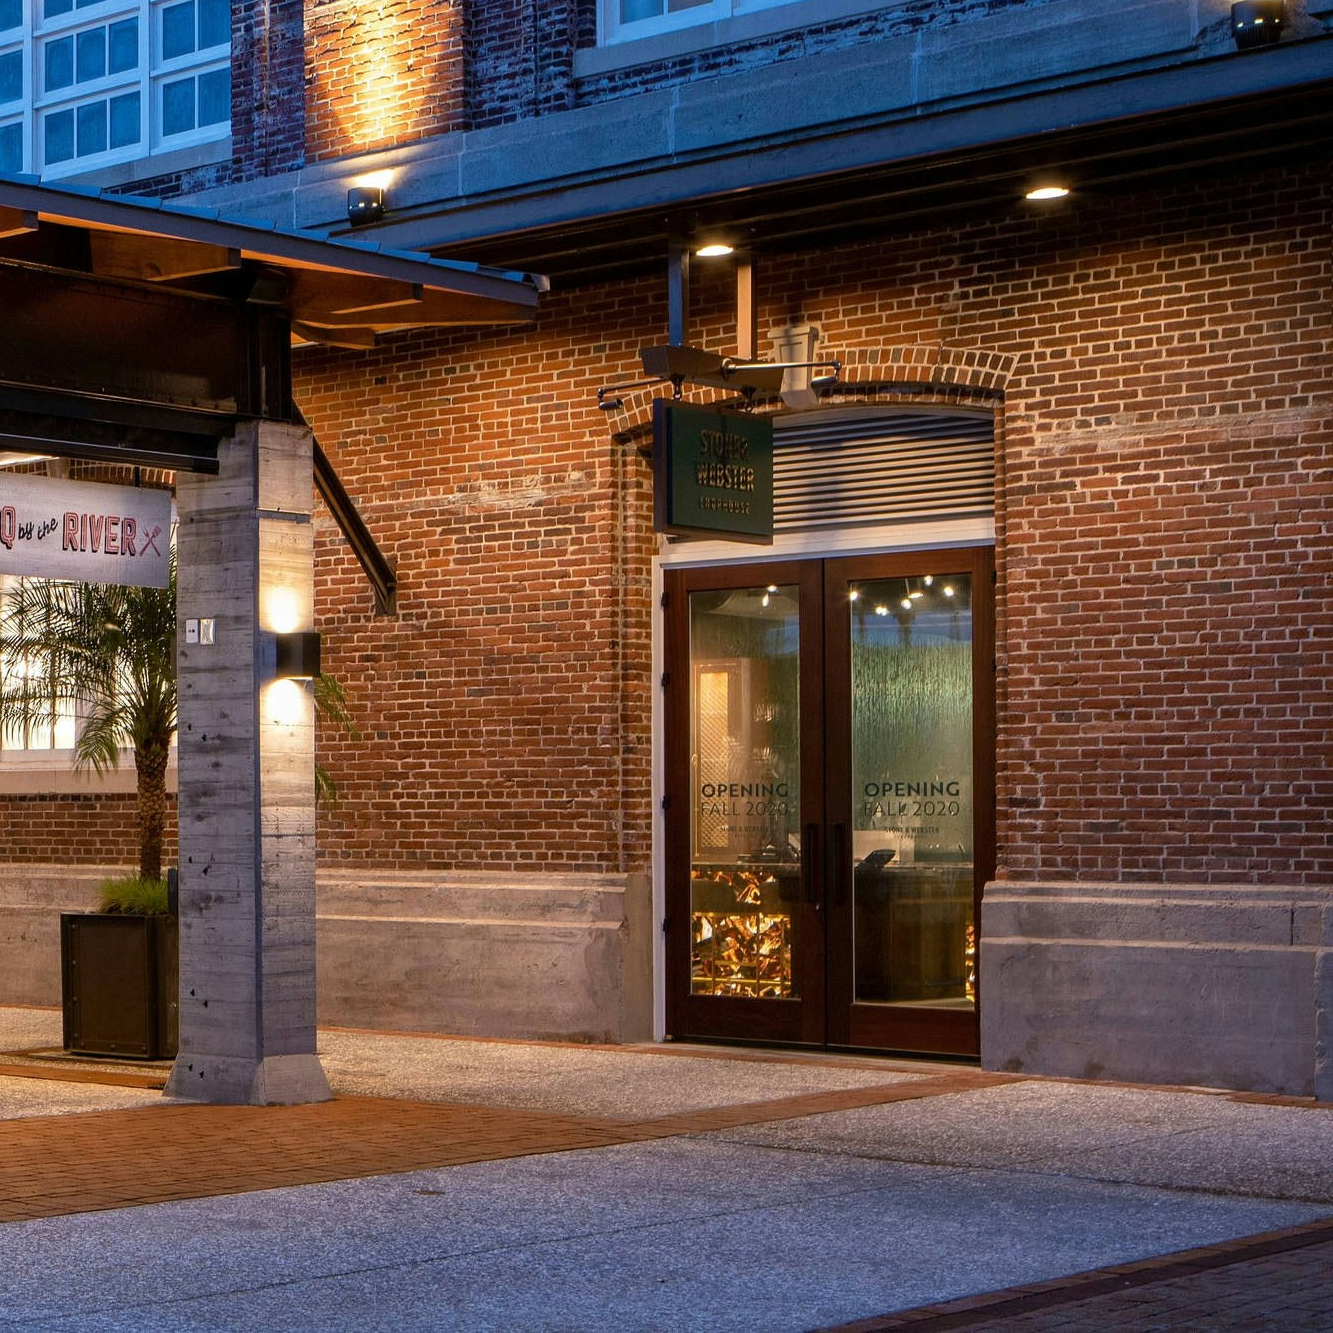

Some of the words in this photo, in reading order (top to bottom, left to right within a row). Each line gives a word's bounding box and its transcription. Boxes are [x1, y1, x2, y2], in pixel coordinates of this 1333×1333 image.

[697, 462, 755, 492] WEBSTER
[18, 522, 35, 540] by
[37, 517, 58, 540] the
[63, 512, 137, 556] RIVER
[701, 783, 788, 797] OPENING
[864, 782, 960, 797] OPENING
[701, 801, 741, 816] FALL
[745, 801, 788, 816] 2020
[864, 801, 908, 816] FALL
[913, 801, 960, 816] 2020
